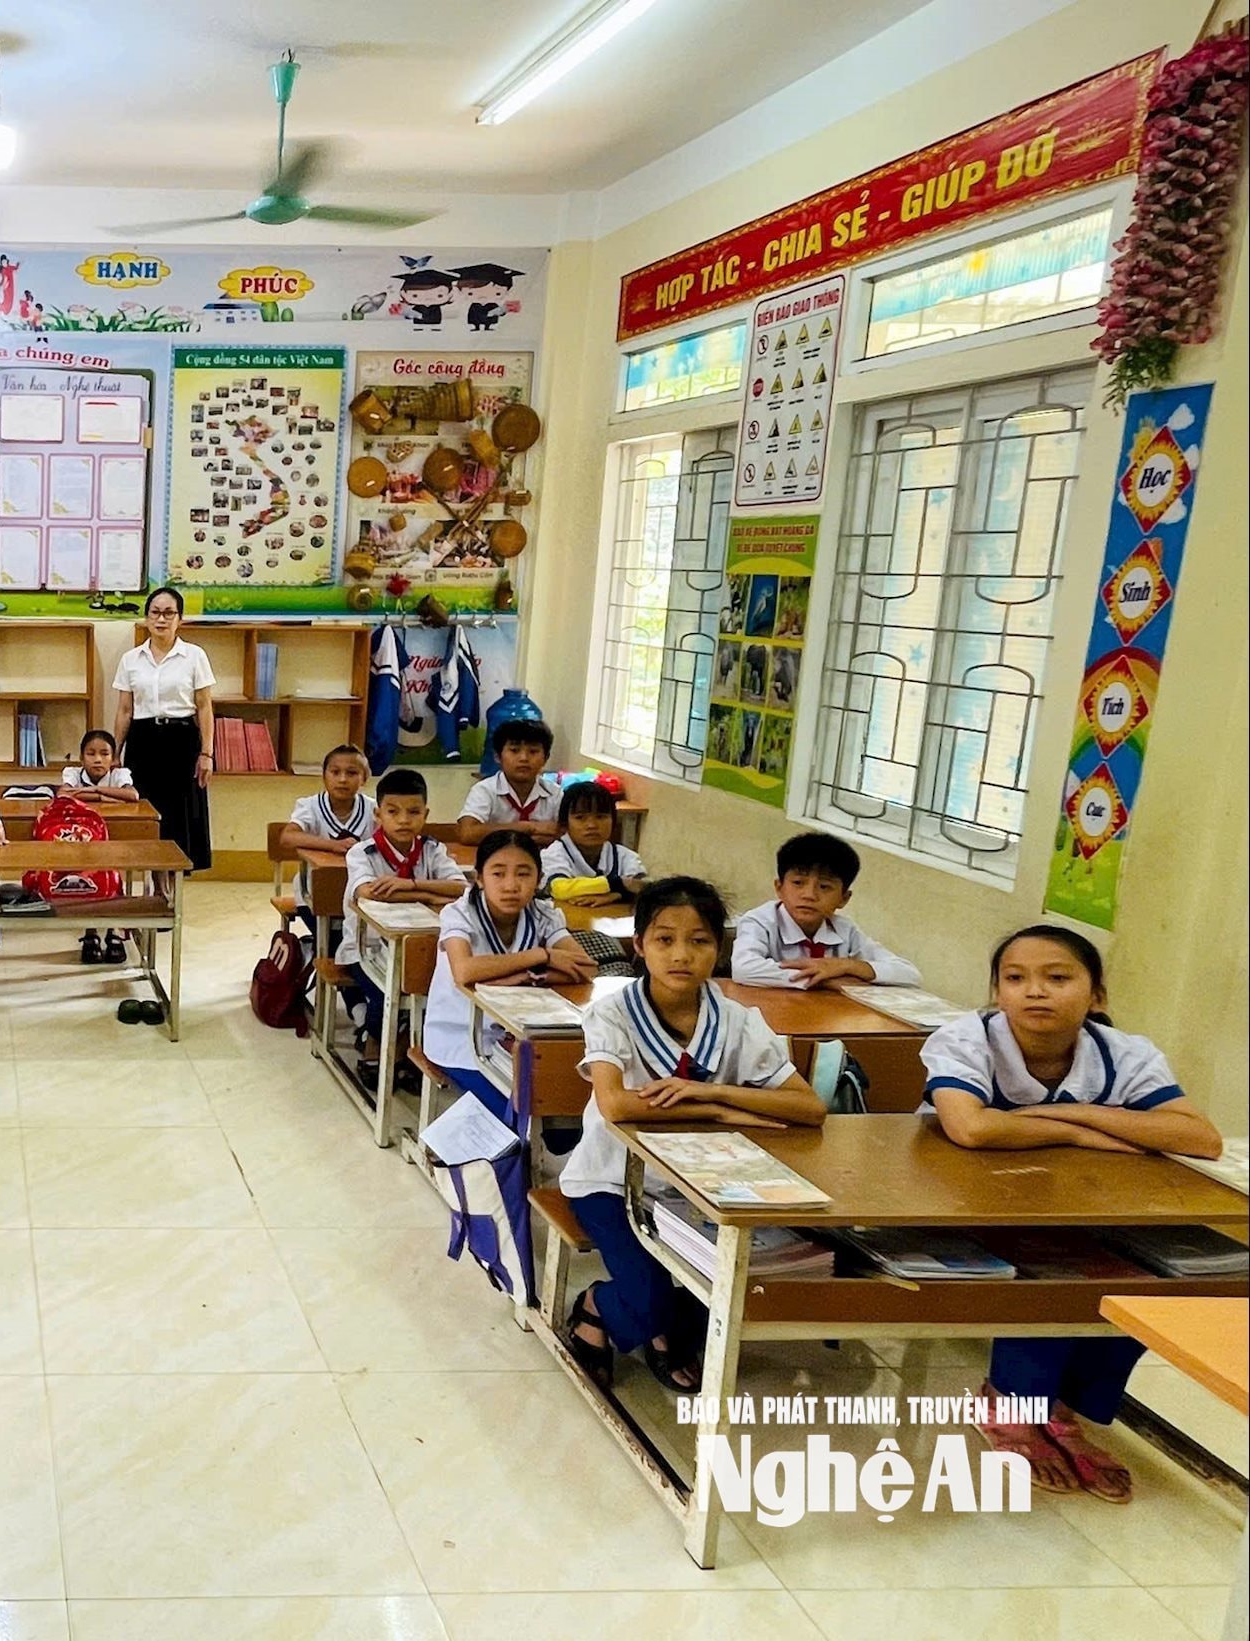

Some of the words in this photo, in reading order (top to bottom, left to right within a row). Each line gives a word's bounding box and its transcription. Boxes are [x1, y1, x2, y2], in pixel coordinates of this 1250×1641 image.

[655, 276, 695, 312] HỢP
[701, 251, 740, 289] TÁC
[763, 231, 823, 274] CHIA
[832, 190, 871, 248] SẺ
[900, 158, 986, 223] GIÚP
[996, 125, 1060, 190] ĐỠ
[97, 262, 158, 281] HẠNH
[240, 273, 298, 294] PHÚC
[15, 346, 74, 365] chúng
[81, 355, 110, 368] em
[185, 353, 211, 366] Cộng
[239, 354, 250, 364] 54
[311, 354, 334, 364] Nam
[393, 358, 422, 374] Góc
[469, 358, 505, 378] đồng
[1139, 467, 1171, 493] Học
[1119, 582, 1151, 603] Sinh
